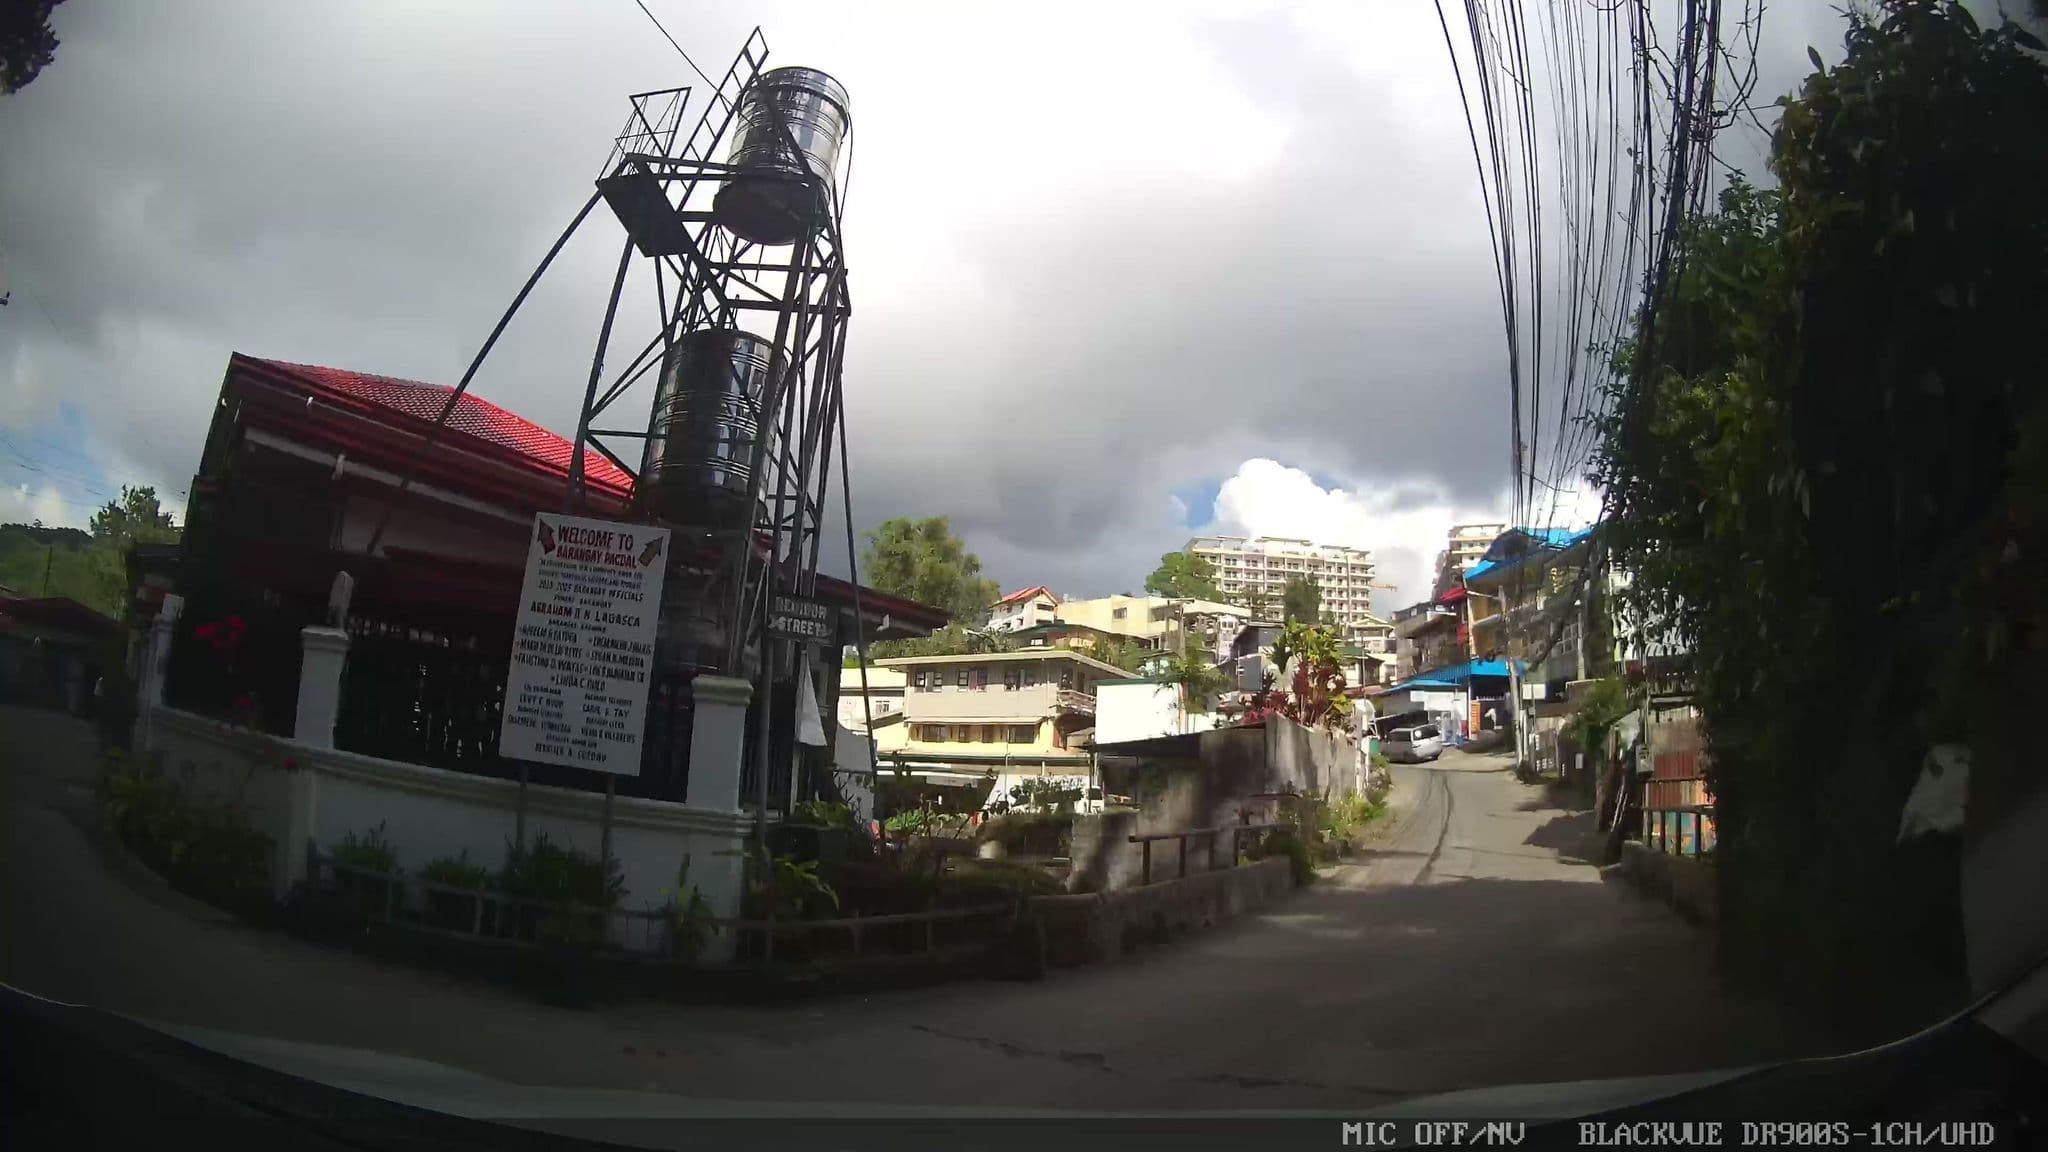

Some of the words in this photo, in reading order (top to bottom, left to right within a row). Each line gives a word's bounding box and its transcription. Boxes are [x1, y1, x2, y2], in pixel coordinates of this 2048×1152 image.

[558, 525, 613, 547] WELCOME
[618, 533, 633, 550] TO
[557, 545, 602, 564] BARANGAY
[608, 588, 644, 602] OFFICIALS
[531, 601, 572, 617] ABRAHAM
[595, 611, 640, 627] LAGASCA
[778, 616, 822, 637] STREET
